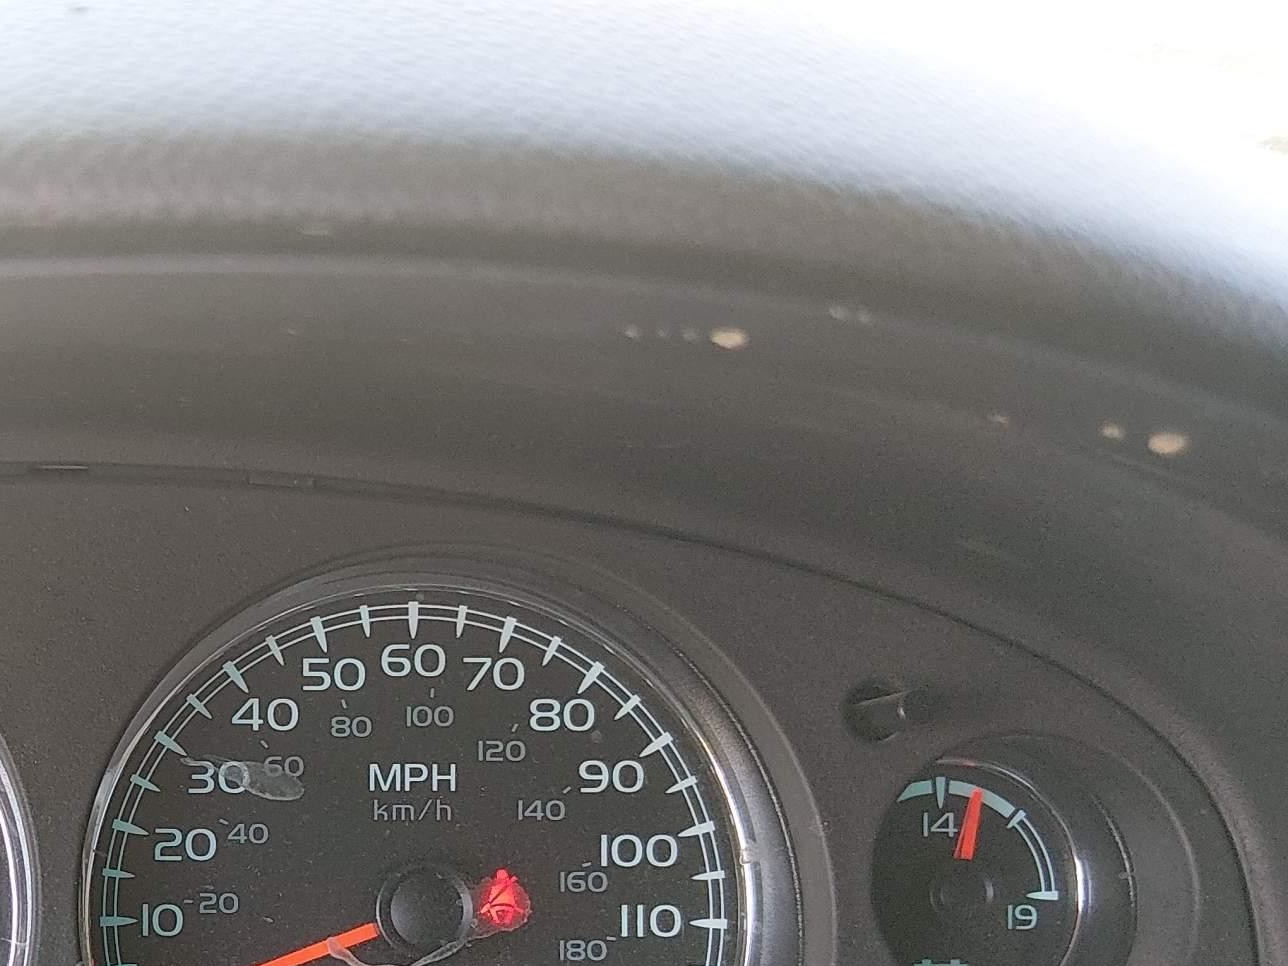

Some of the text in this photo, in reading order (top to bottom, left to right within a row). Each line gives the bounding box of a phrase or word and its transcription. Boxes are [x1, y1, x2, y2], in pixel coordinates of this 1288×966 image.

[380, 644, 446, 677] 60
[301, 657, 366, 691] 50
[463, 657, 525, 691] 70
[232, 698, 299, 731] 40
[331, 716, 372, 737] 80
[405, 706, 454, 727] 100
[529, 699, 595, 732] 80
[478, 740, 525, 762] 120
[188, 760, 250, 793] 30
[264, 756, 304, 777] 60
[369, 764, 457, 791] MPH
[579, 759, 645, 793] 90
[373, 799, 451, 821] km/h
[517, 800, 565, 821] 140
[228, 823, 269, 844] 40
[922, 813, 958, 838] 14
[154, 828, 217, 861] 20
[600, 835, 679, 868] 100
[559, 871, 608, 893] 160
[199, 892, 239, 914] 20
[142, 903, 184, 937] 10
[620, 905, 682, 938] 110
[1007, 905, 1038, 931] 19
[559, 939, 607, 961] 180
